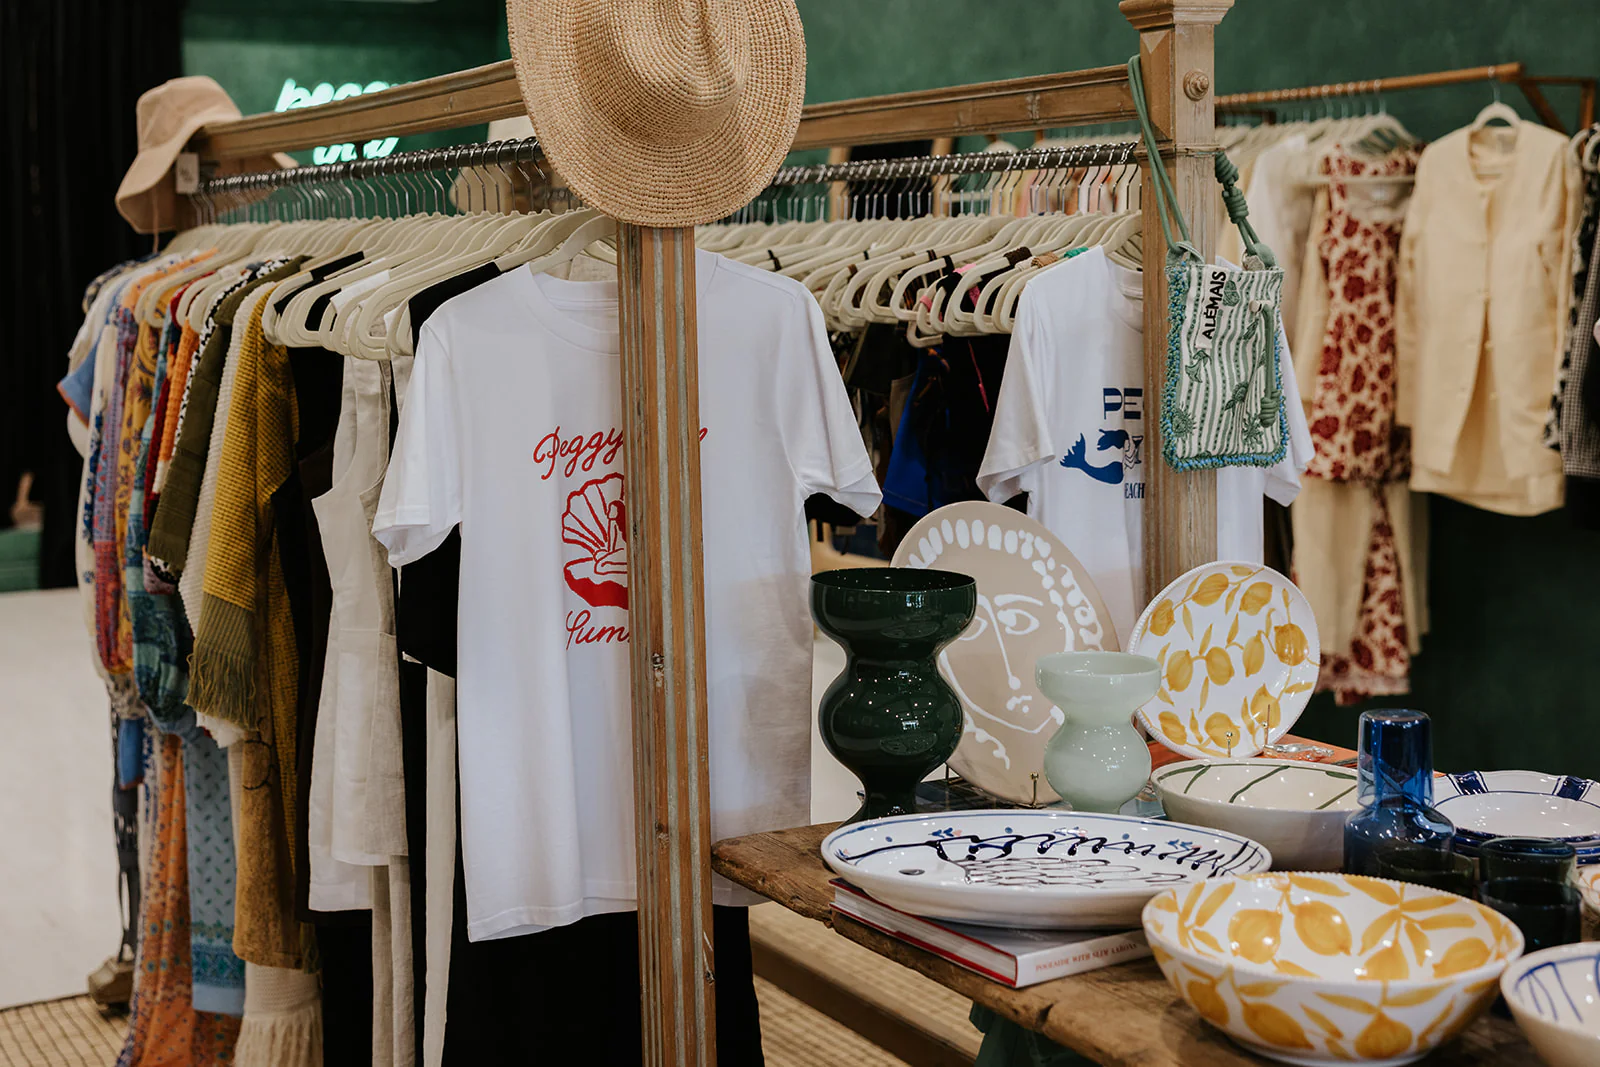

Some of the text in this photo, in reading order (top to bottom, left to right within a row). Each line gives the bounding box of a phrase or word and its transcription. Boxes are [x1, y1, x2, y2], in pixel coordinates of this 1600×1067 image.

[1202, 271, 1227, 340] ALÉMAIS
[1103, 387, 1144, 420] PE
[533, 425, 624, 480] Peggy
[565, 609, 630, 651] Yum
[1072, 953, 1091, 963] WITH
